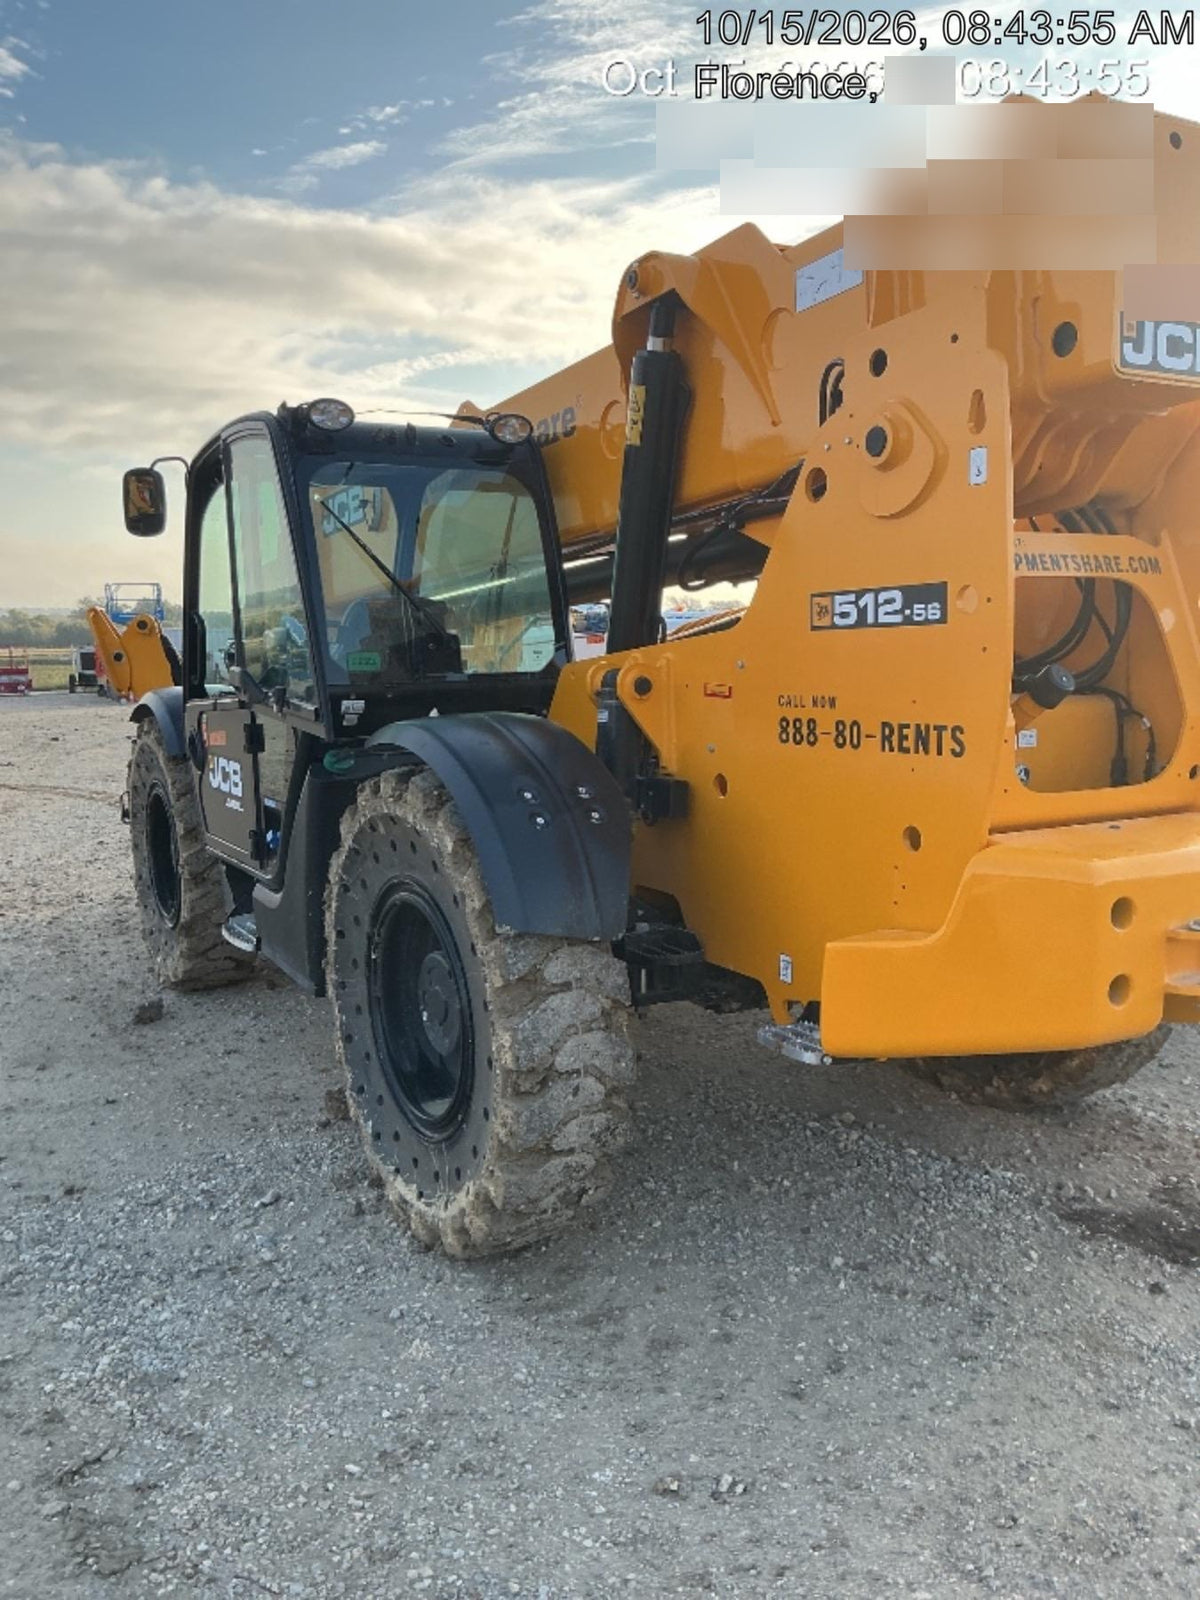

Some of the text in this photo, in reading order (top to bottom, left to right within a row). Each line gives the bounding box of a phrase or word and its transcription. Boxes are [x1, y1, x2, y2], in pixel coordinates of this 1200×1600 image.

[1122, 320, 1200, 373] JC
[778, 695, 837, 710] CALL NOW
[778, 715, 966, 758] 888-80-RENTS
[209, 756, 243, 797] JCB
